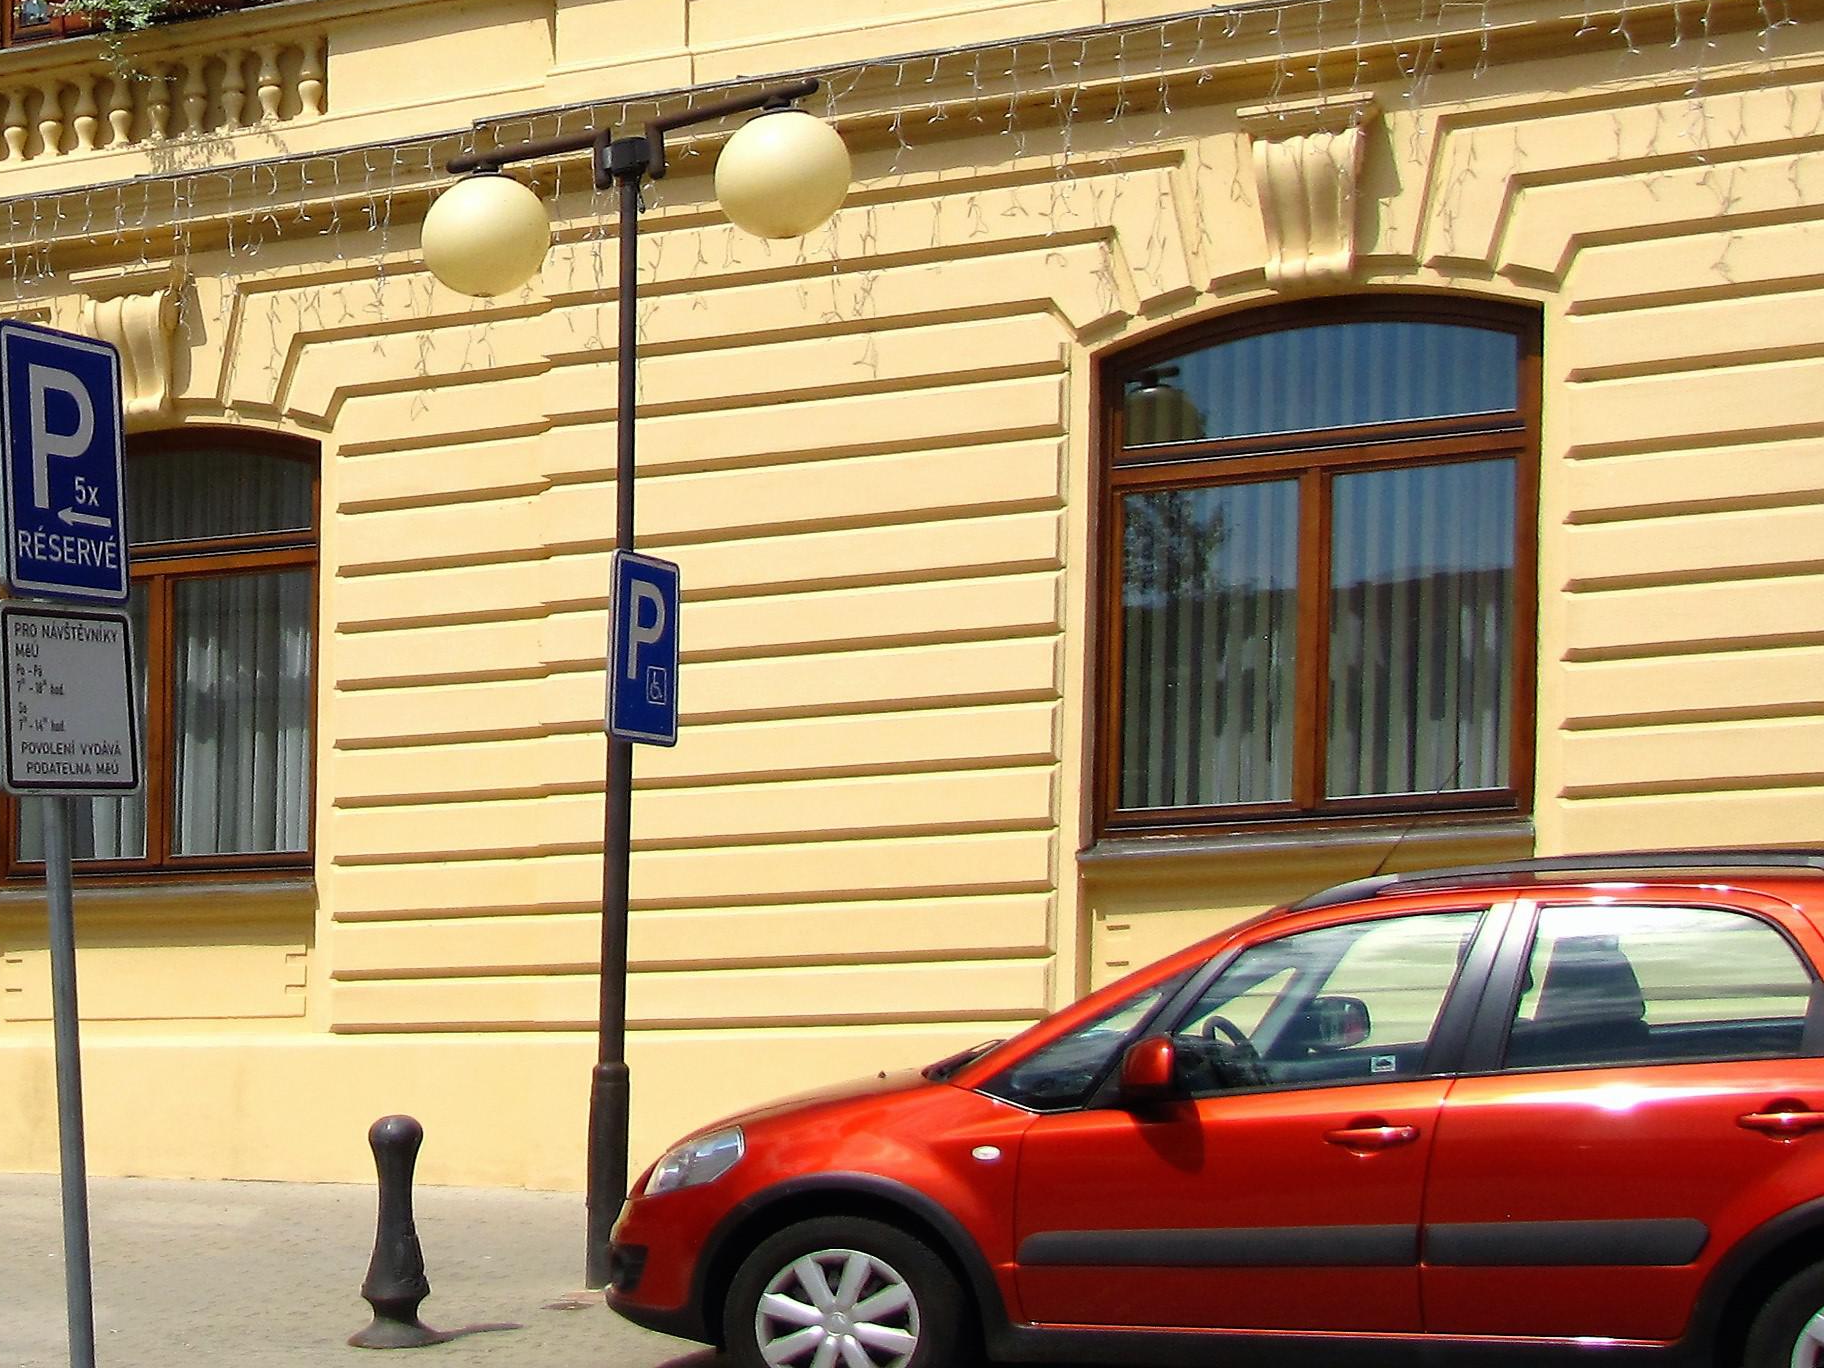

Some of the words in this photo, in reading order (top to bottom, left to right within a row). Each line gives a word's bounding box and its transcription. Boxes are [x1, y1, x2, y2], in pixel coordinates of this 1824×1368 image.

[28, 362, 95, 510] P
[75, 476, 100, 507] 5x
[17, 524, 119, 569] RÉSERVÉ
[14, 622, 38, 638] PRO
[627, 579, 666, 680] P
[21, 739, 75, 755] POVOLENÍ
[80, 739, 122, 756] VYDÁVÁ
[26, 761, 92, 775] PODATELNA
